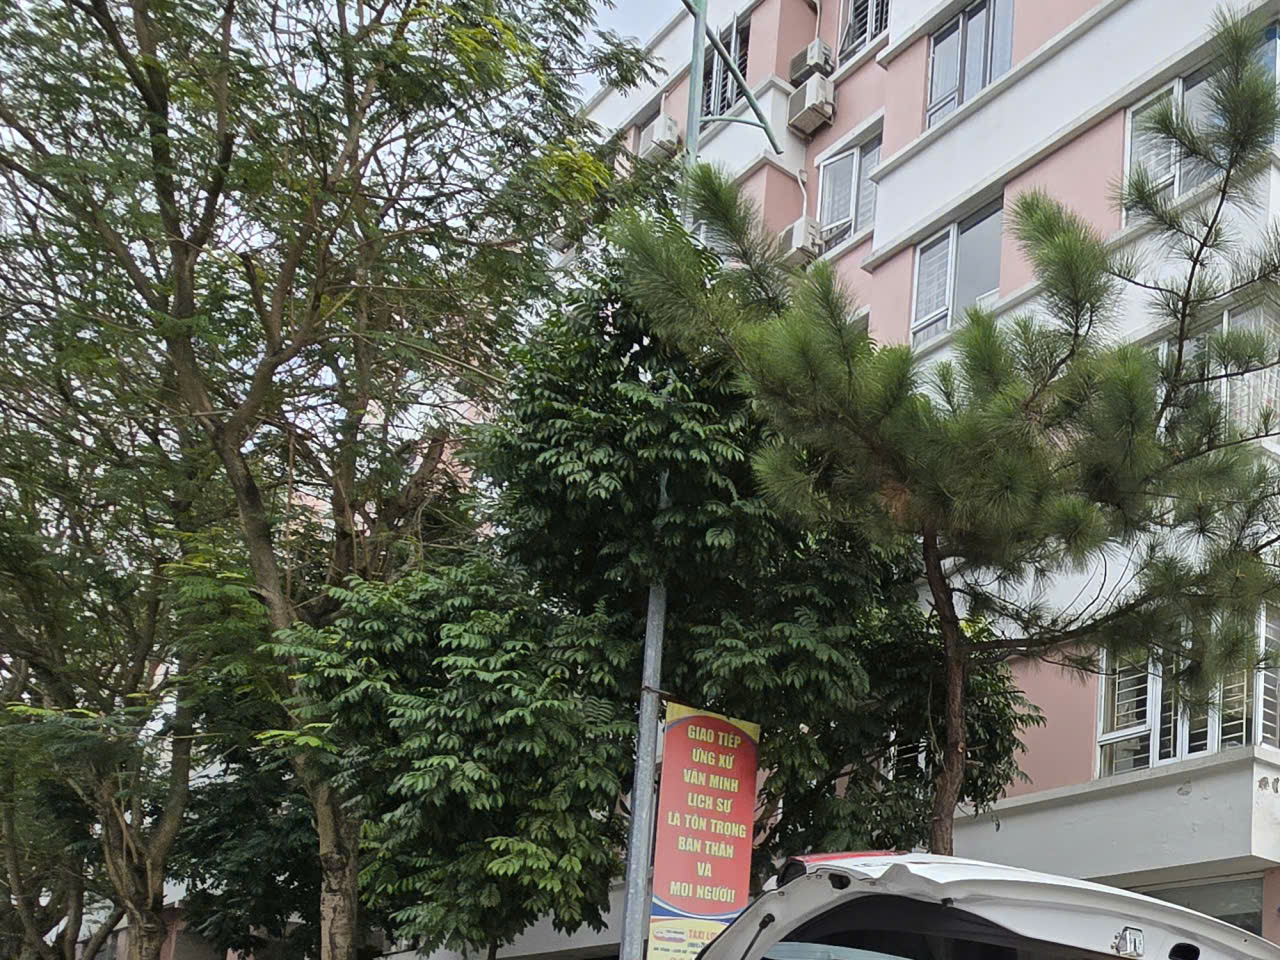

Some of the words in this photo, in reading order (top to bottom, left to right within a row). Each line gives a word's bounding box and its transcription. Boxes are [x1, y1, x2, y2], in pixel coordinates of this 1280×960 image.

[687, 725, 715, 743] GIAO
[718, 731, 742, 748] TIẾP
[692, 746, 716, 766] ỨNG
[683, 768, 706, 786] VĂN
[708, 774, 739, 792] MINH
[716, 798, 733, 816] SỰ
[667, 810, 681, 827] LÀ
[684, 813, 707, 831] TÔN
[710, 818, 747, 838] TRỌNG
[705, 841, 734, 858] THÂN
[697, 861, 712, 877] VÀ
